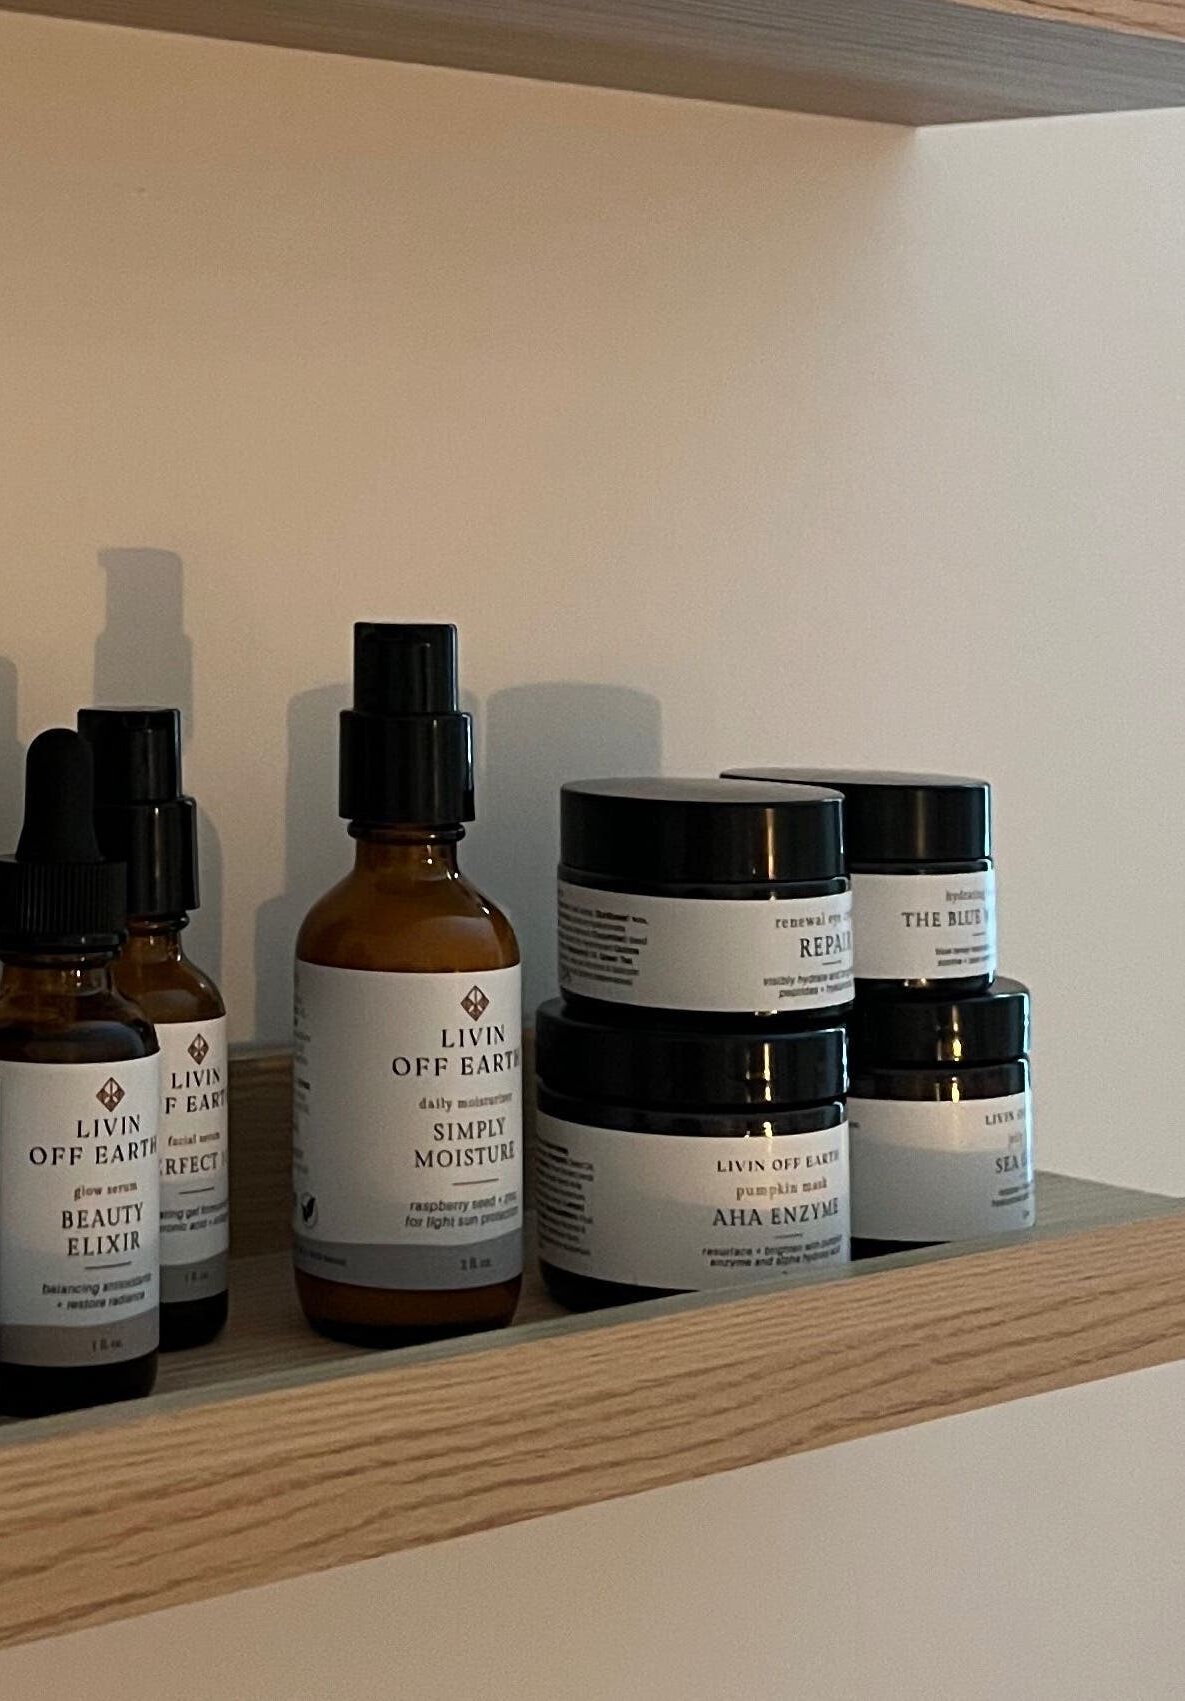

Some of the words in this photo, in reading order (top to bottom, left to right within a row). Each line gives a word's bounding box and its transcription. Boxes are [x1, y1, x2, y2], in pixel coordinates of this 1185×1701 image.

[946, 889, 985, 903] hydrat
[775, 912, 826, 928] renewal
[901, 911, 941, 927] THE
[948, 908, 981, 926] BLUE
[442, 1024, 505, 1047] LIVIN
[392, 1056, 448, 1076] OFF
[171, 1067, 221, 1089] LIVIN
[187, 1089, 225, 1112] EART
[419, 1097, 452, 1112] daily
[77, 1114, 140, 1138] LIVIN
[434, 1117, 505, 1141] SIMPLY
[29, 1146, 83, 1165] OFF
[95, 1135, 158, 1164] EARTH
[415, 1141, 514, 1168] MOISTURE
[159, 1151, 217, 1175] RFECT
[717, 1160, 765, 1172] LIVIN
[772, 1157, 800, 1171] OFF
[995, 1156, 1020, 1174] SEA
[74, 1185, 102, 1200] glow
[107, 1181, 138, 1195] serum
[736, 1181, 798, 1200] pumpkin
[803, 1176, 827, 1192] mask
[62, 1202, 143, 1229] BEAUTY
[410, 1200, 469, 1212] raspberry
[712, 1208, 763, 1226] AHA
[770, 1197, 838, 1225] ENZYME
[405, 1216, 423, 1228] for
[427, 1216, 455, 1230] light
[458, 1216, 478, 1227] sun
[67, 1231, 141, 1256] ELIXIR
[42, 1283, 101, 1296] balancing
